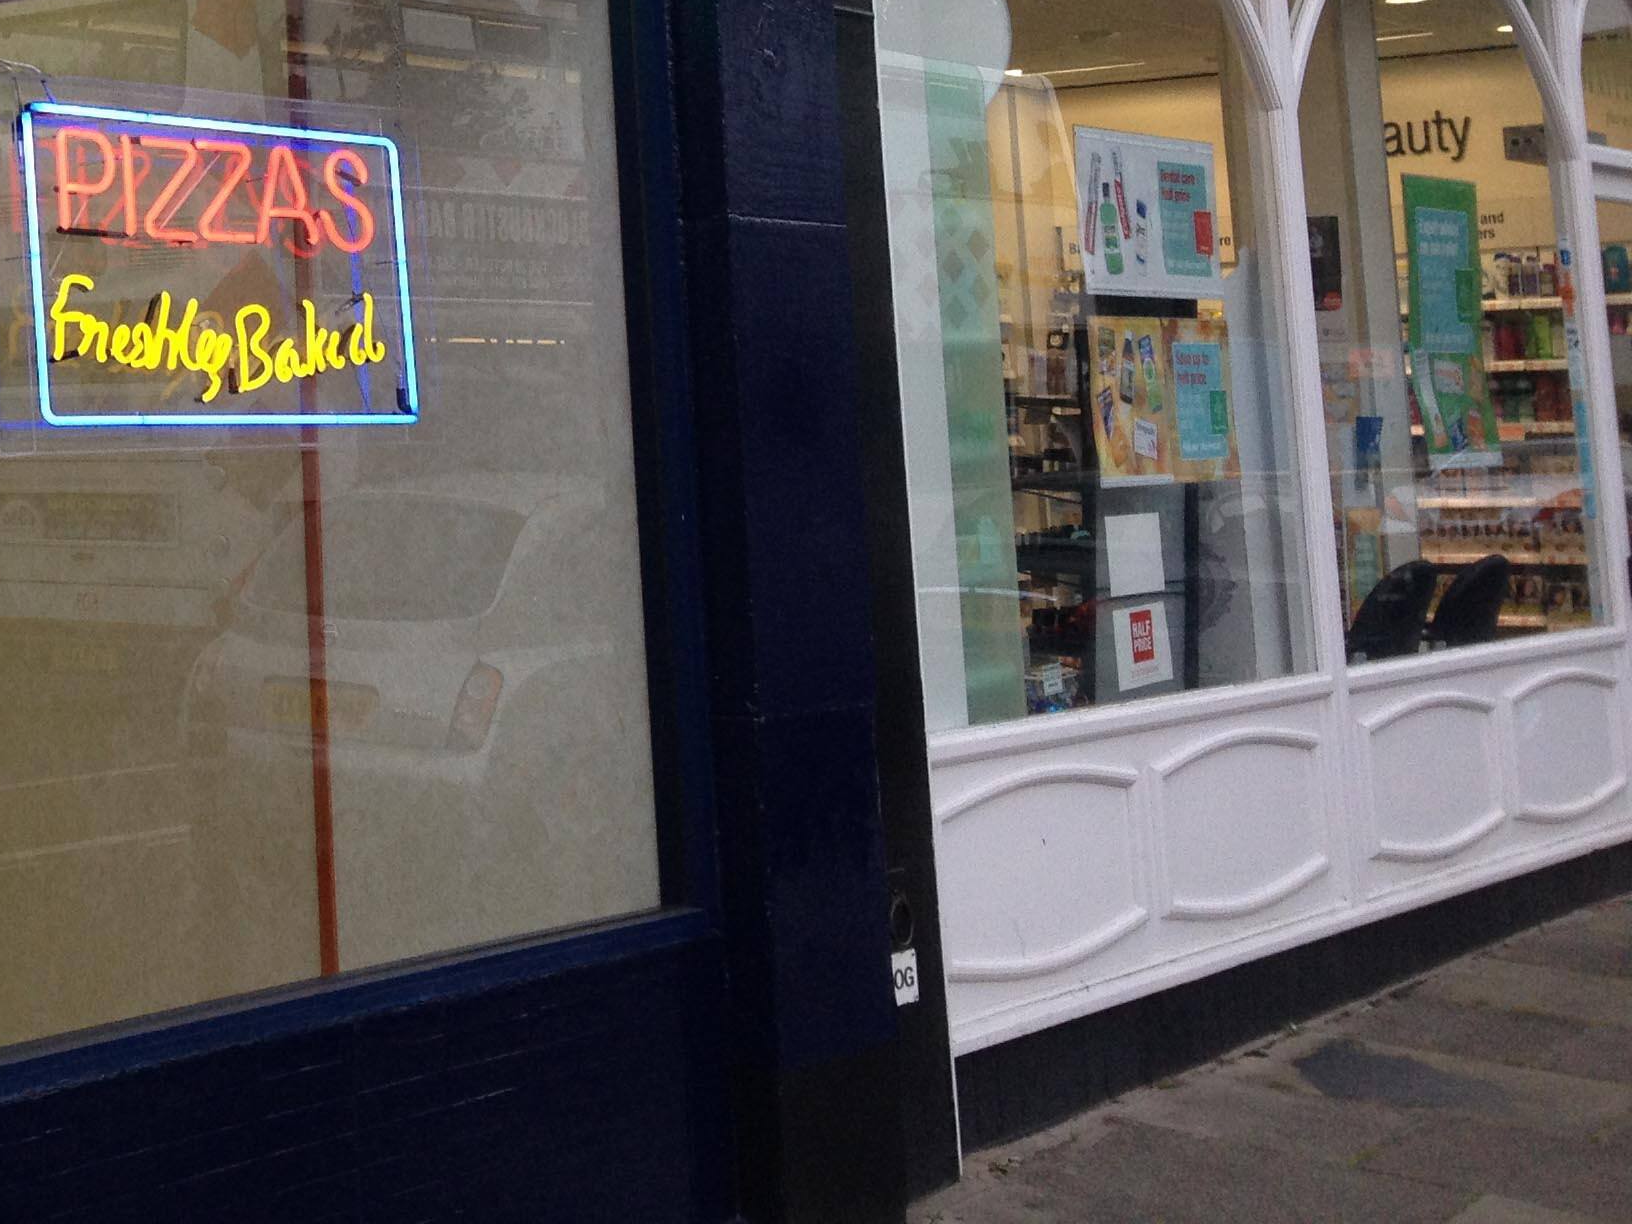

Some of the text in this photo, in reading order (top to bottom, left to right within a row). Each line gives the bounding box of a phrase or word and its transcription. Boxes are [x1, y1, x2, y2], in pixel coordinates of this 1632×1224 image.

[55, 127, 375, 252] PIZZAS
[1480, 212, 1504, 225] and
[50, 274, 386, 403] Freshly Baked
[1132, 620, 1151, 637] HALF
